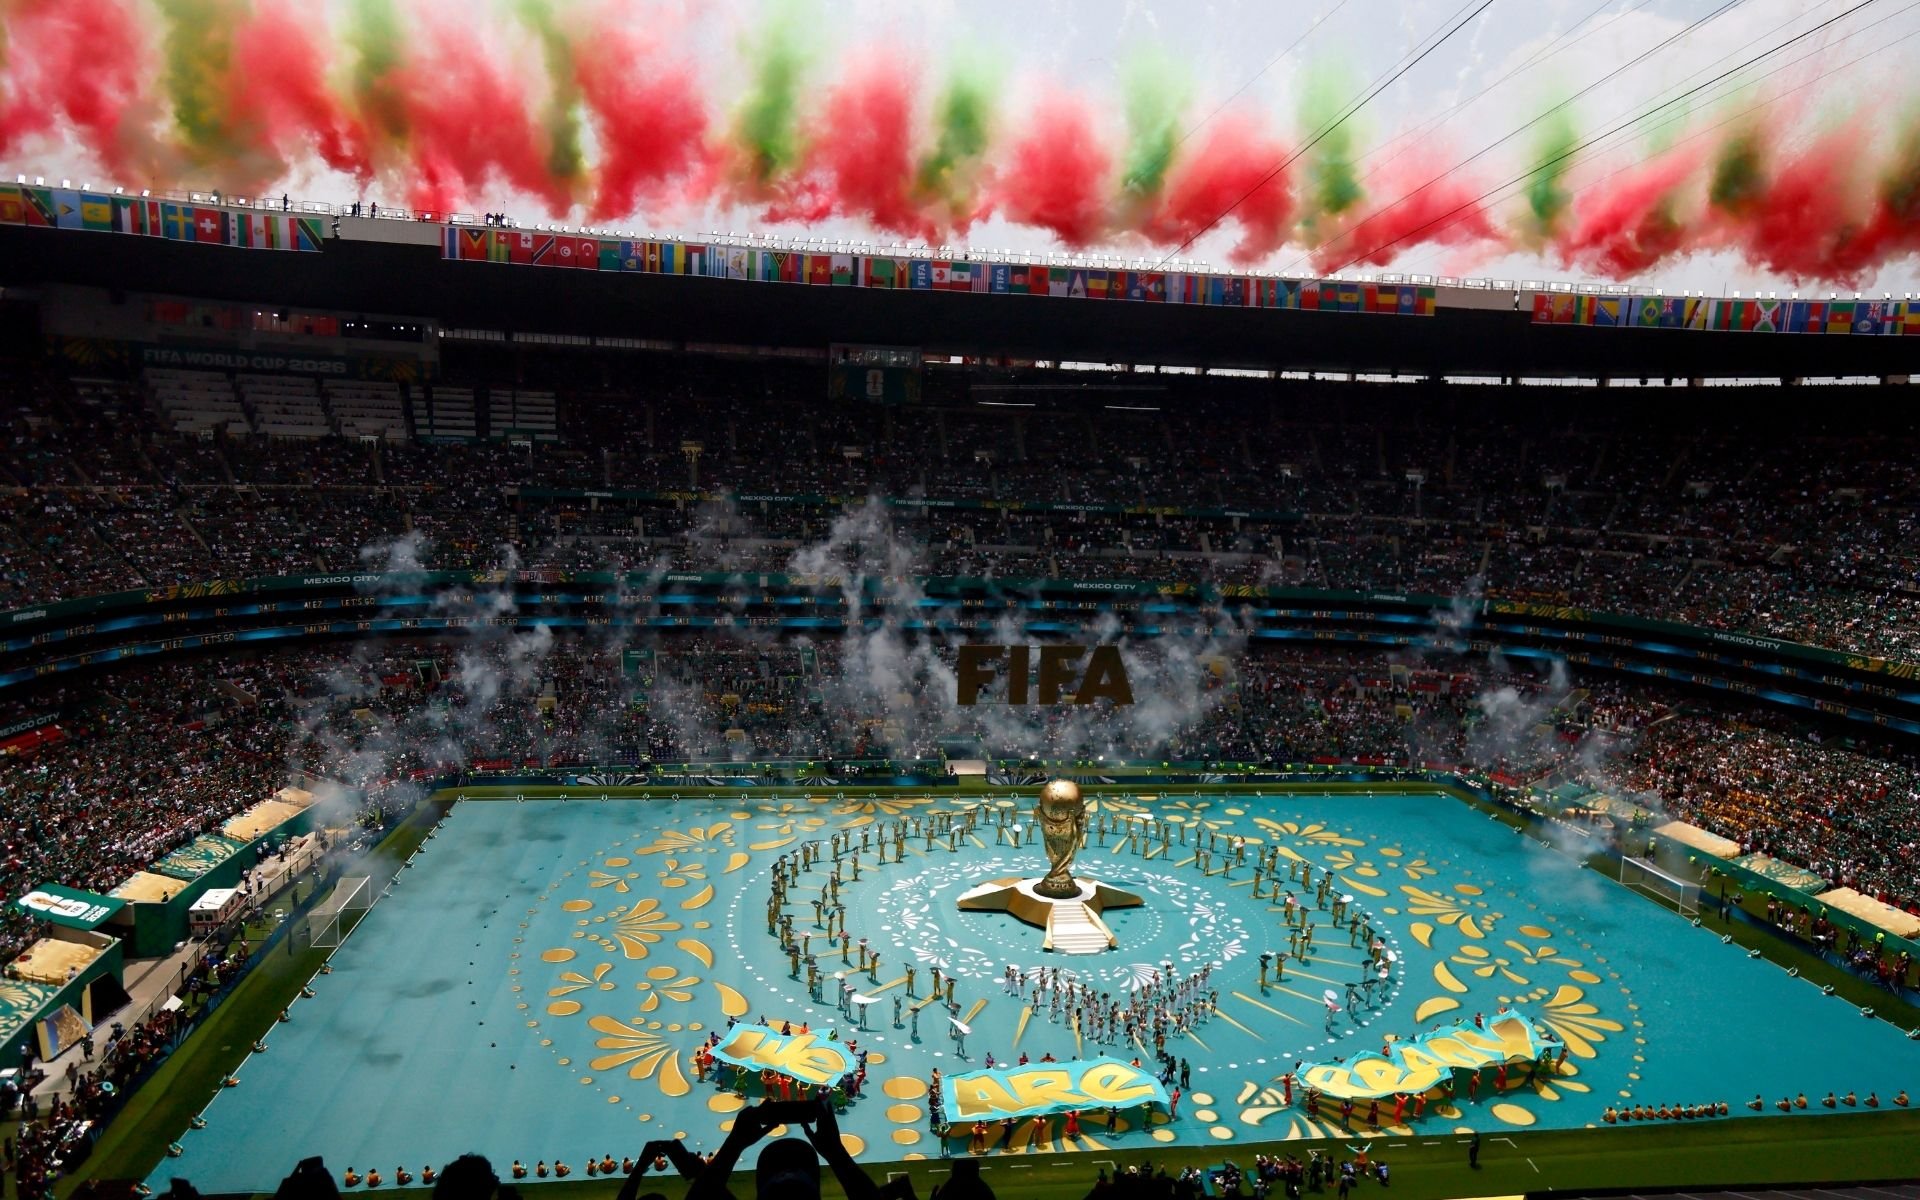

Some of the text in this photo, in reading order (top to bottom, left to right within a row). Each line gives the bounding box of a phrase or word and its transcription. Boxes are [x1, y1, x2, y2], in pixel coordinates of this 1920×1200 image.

[918, 264, 926, 286] FIFA
[997, 269, 1005, 290] FIFA
[144, 349, 347, 374] FIFA WORLD CUP 2026
[303, 575, 380, 585] MEXICO CITY
[1073, 582, 1136, 591] MEXICO CITY
[1713, 632, 1780, 650] MEXICO CITY
[958, 645, 1134, 706] FIFA
[37, 711, 61, 727] CITY
